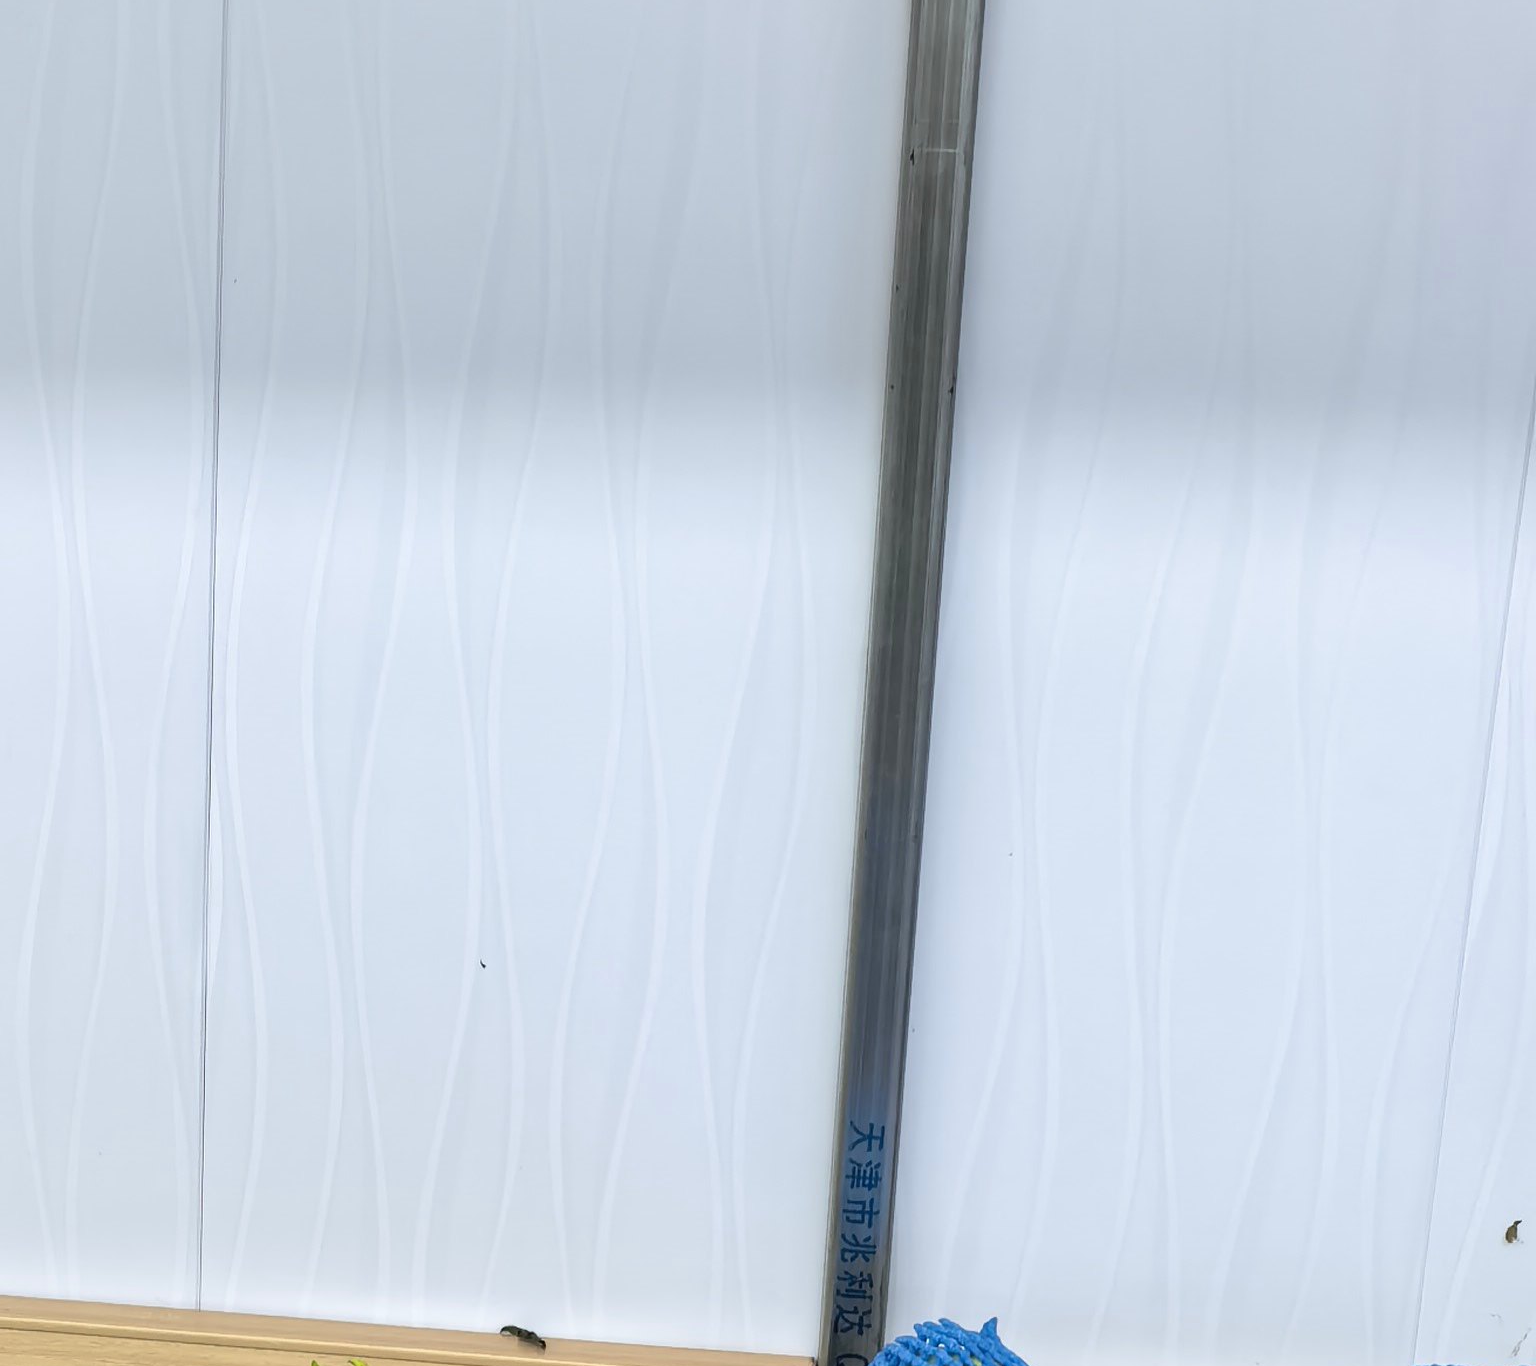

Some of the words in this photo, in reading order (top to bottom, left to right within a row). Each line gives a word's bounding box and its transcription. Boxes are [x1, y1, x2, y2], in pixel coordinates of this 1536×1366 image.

[833, 1120, 885, 1337] 天津市兆利达
